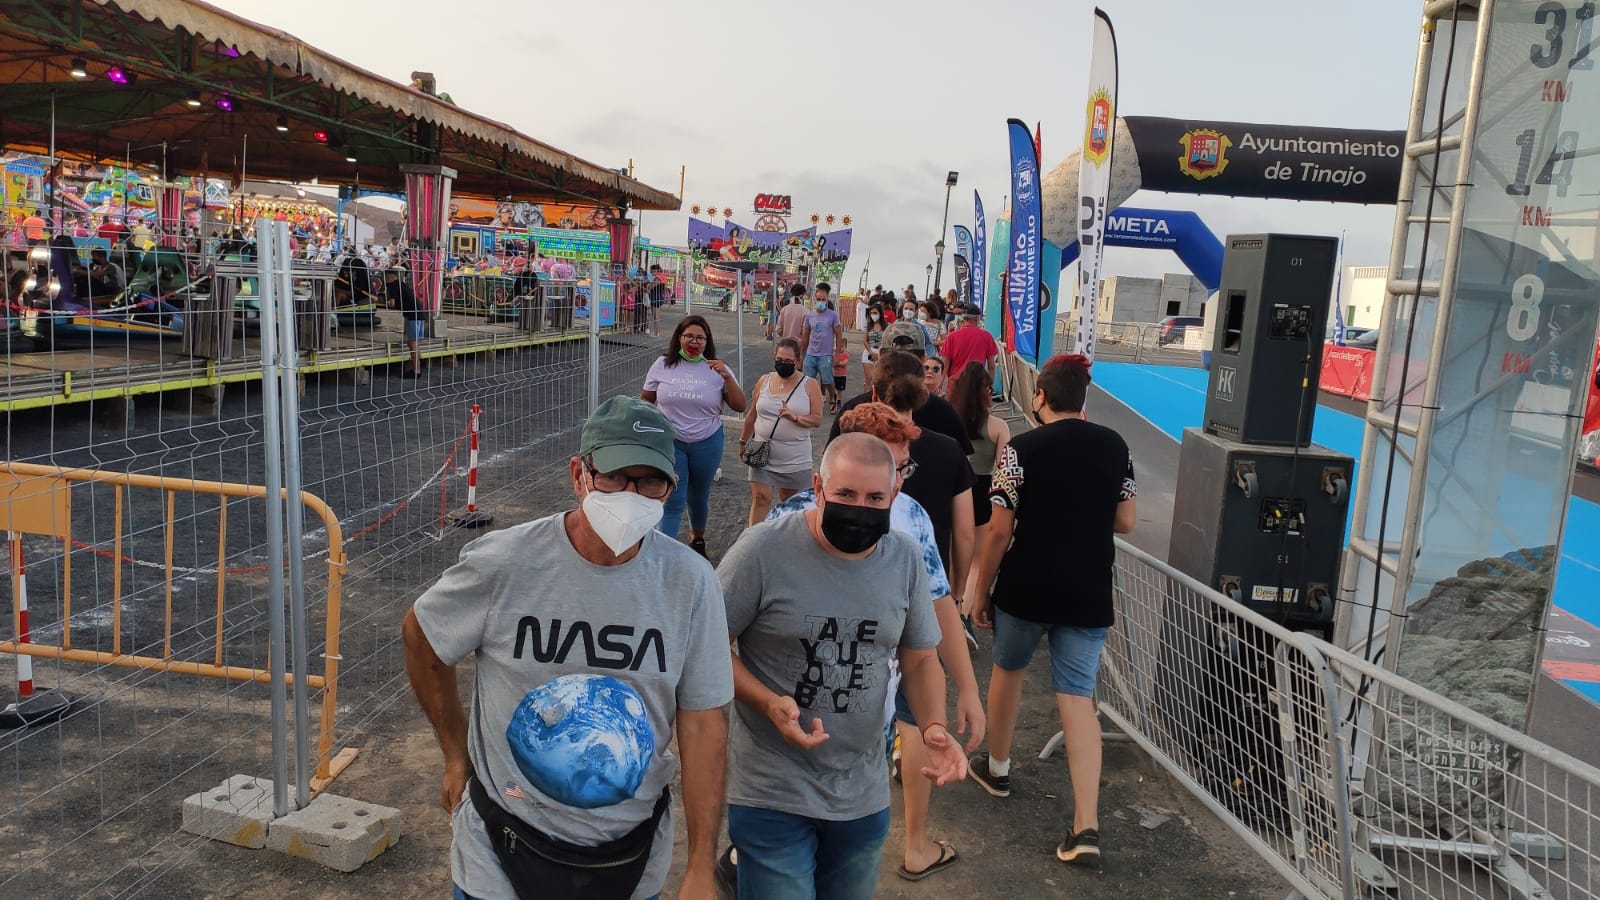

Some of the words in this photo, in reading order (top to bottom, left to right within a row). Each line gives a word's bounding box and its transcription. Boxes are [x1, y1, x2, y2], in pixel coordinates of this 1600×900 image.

[1530, 1, 1595, 71] 31
[1541, 80, 1573, 102] KM
[1239, 132, 1399, 158] Ayuntamiento
[1264, 163, 1292, 181] de
[1300, 162, 1366, 186] Tinajo
[1506, 129, 1579, 197] 14
[1108, 216, 1170, 234] META
[1522, 205, 1552, 226] KM
[543, 249, 574, 258] GAMES
[1507, 273, 1545, 341] 8
[1502, 352, 1533, 374] KM
[1218, 368, 1234, 394] HK
[803, 614, 879, 643] TAKE
[513, 615, 667, 672] NASA
[799, 637, 874, 667] YOUR
[785, 654, 881, 691] POWER
[794, 681, 870, 713] BACK
